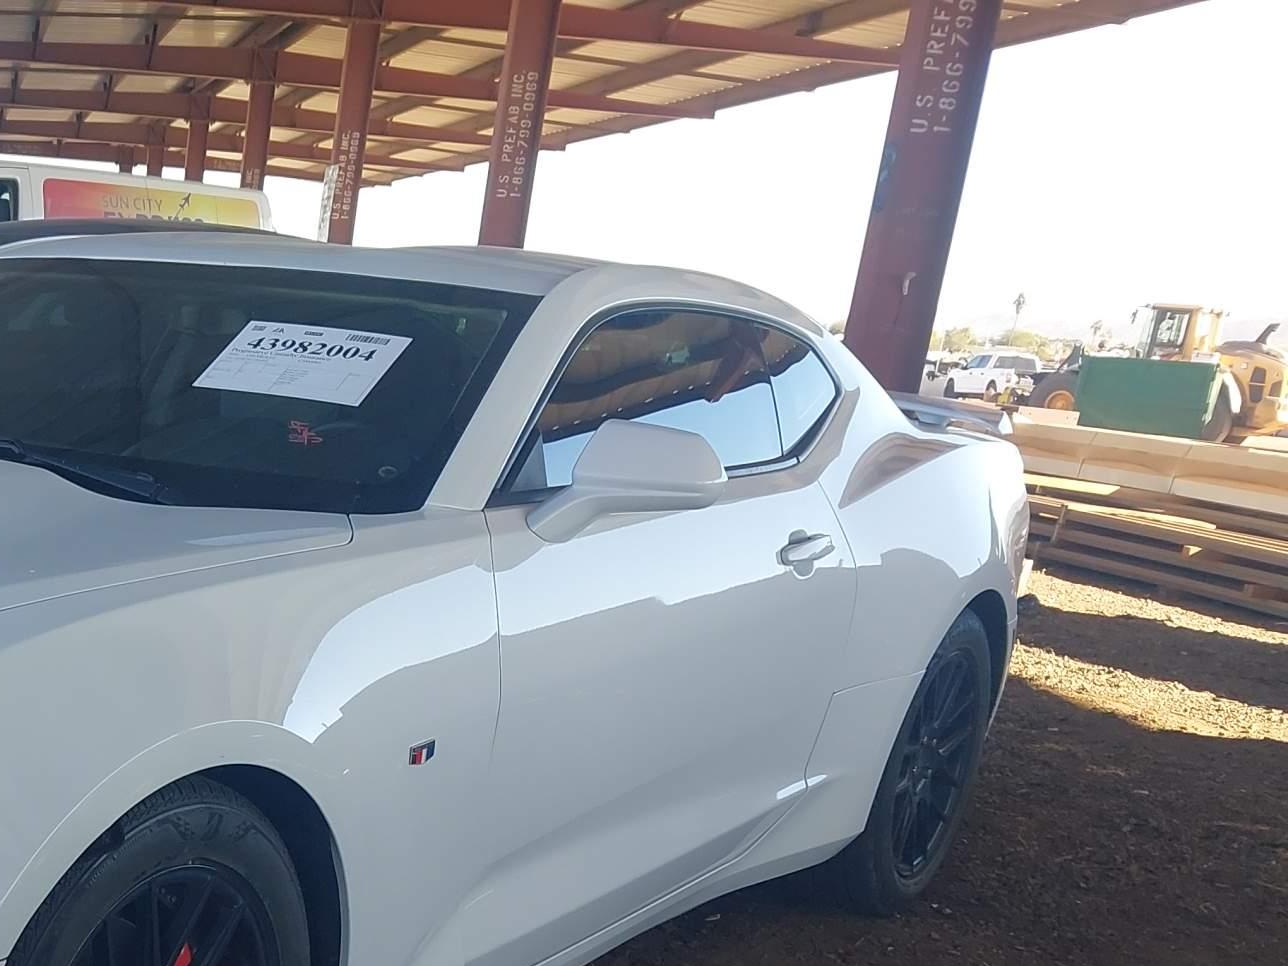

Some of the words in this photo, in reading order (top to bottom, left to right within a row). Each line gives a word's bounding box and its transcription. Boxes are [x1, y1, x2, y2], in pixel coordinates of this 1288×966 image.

[502, 106, 520, 162] PREFAB
[510, 71, 538, 197] 1-866-799-0969
[102, 193, 129, 209] SUN
[133, 197, 162, 211] CITY
[247, 336, 377, 362] 43982004
